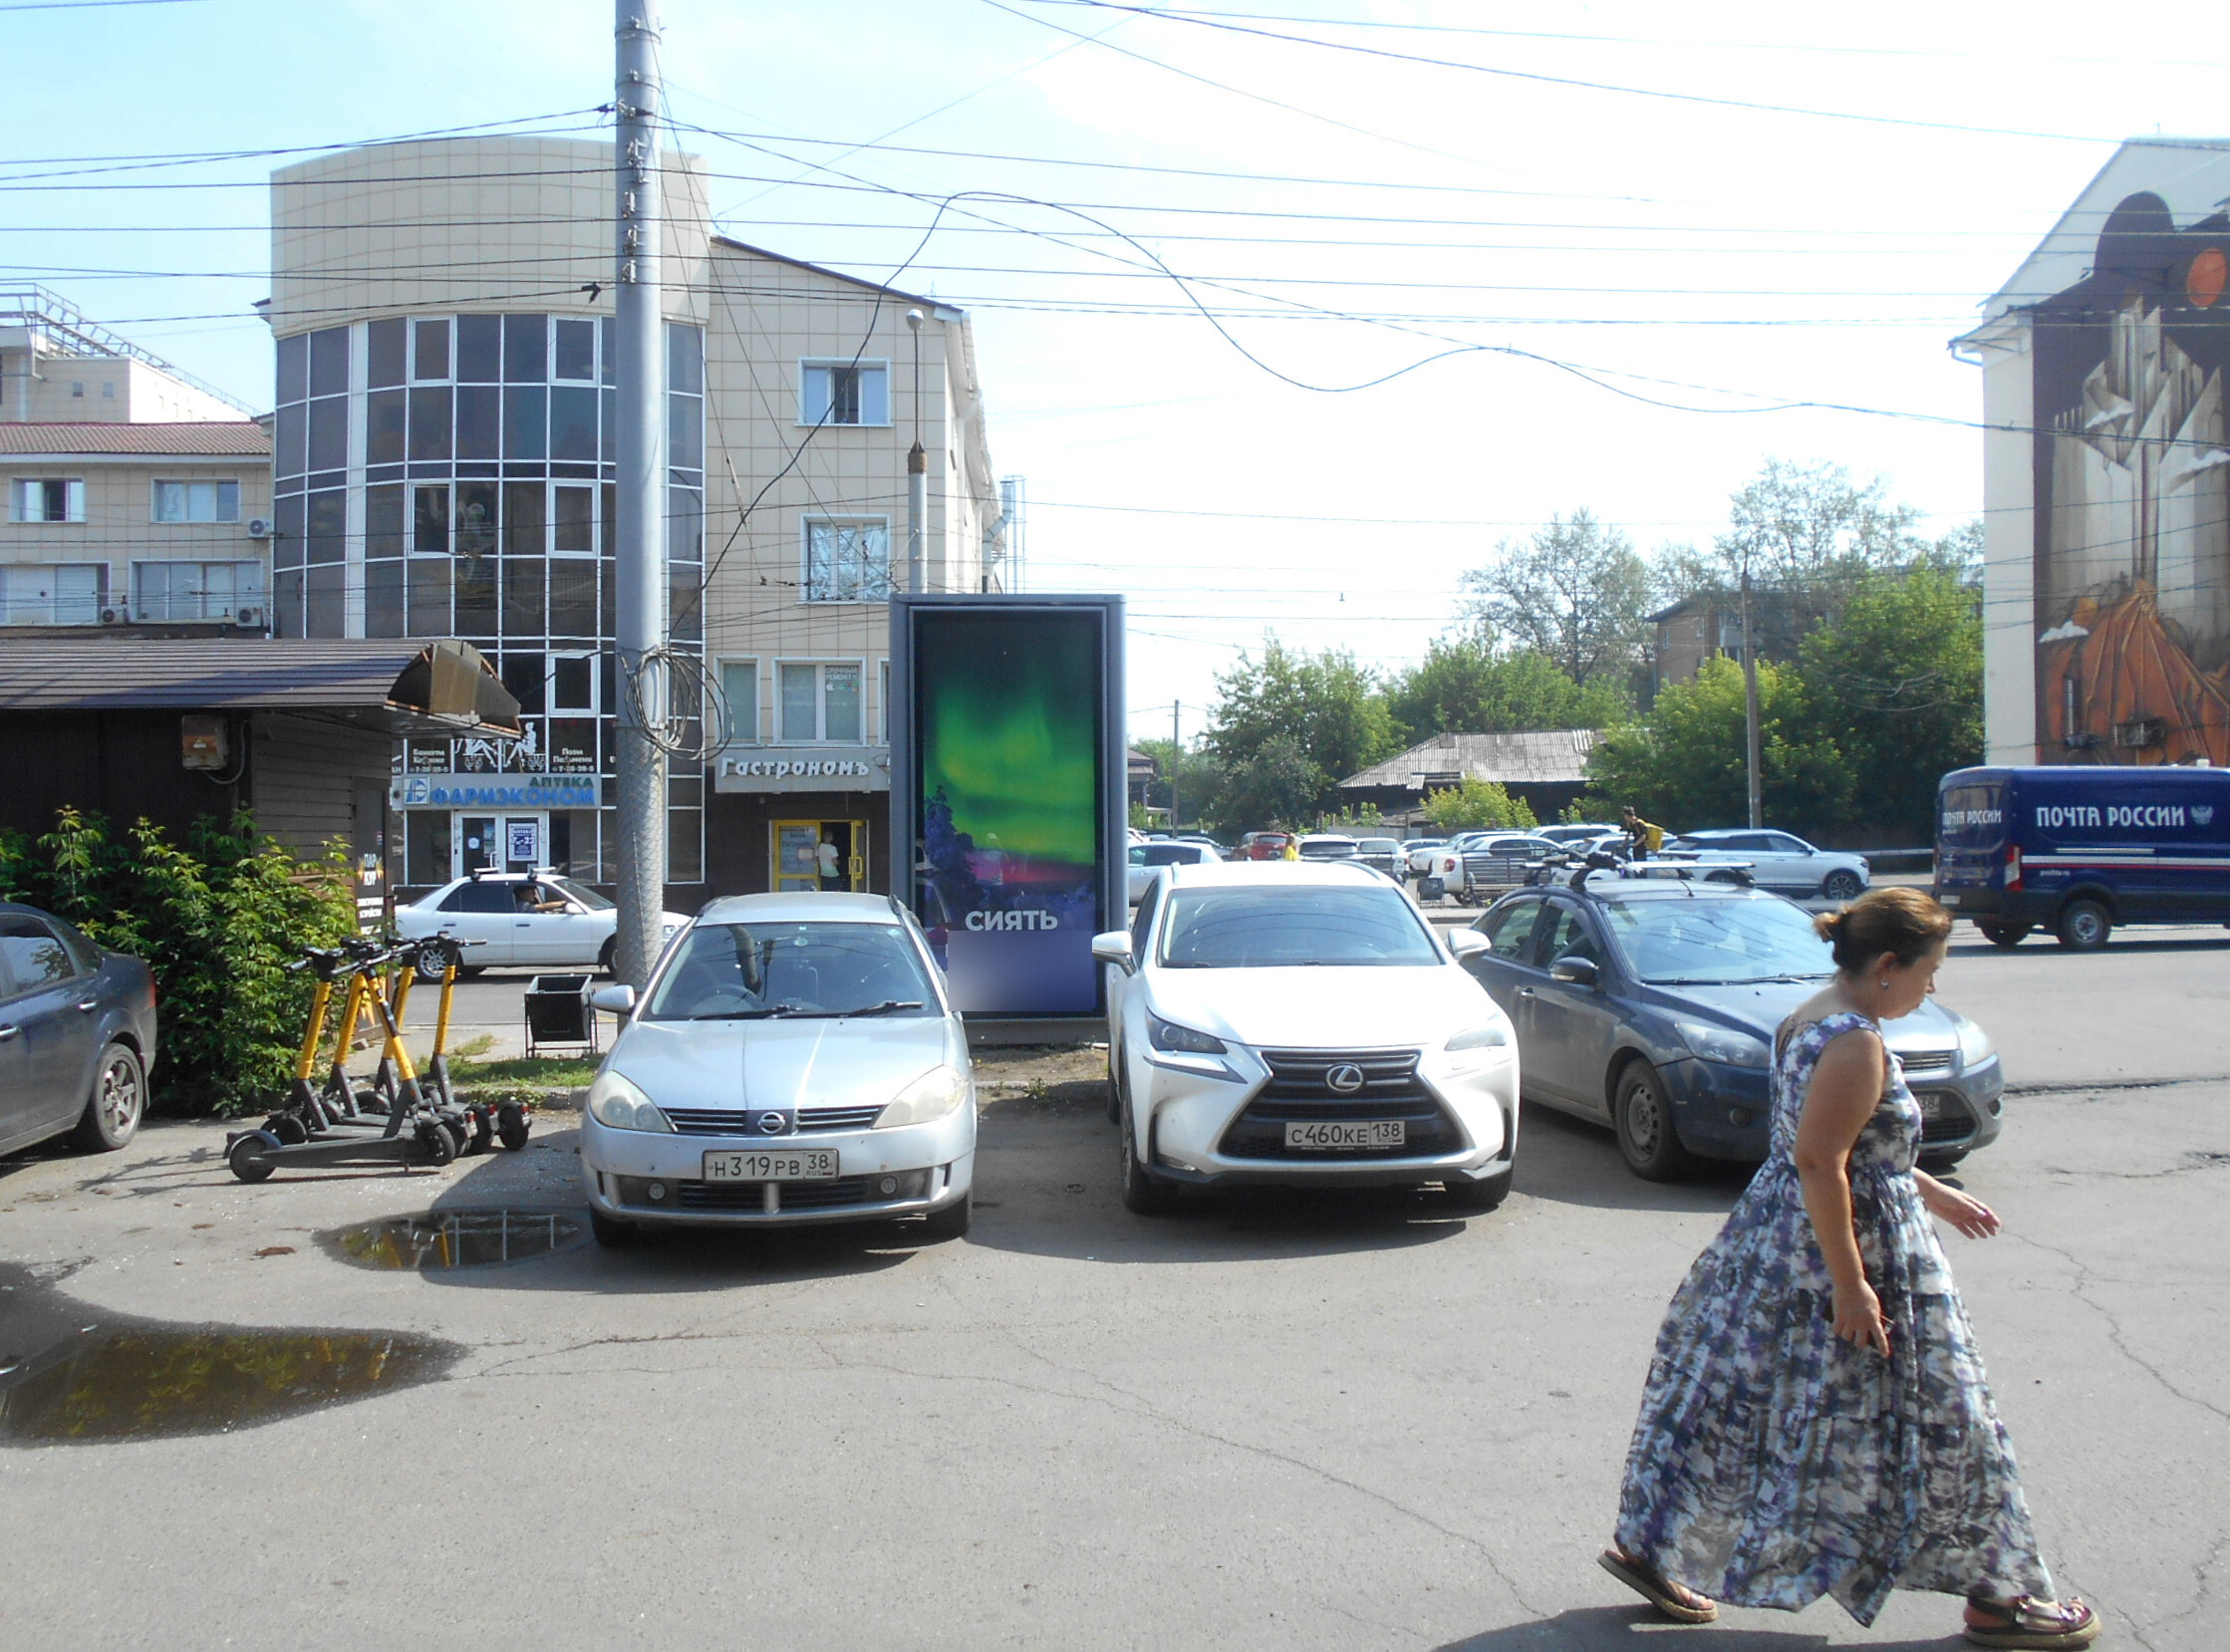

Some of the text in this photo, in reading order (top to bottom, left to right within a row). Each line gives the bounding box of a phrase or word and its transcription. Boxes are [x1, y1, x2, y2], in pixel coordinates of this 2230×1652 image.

[720, 757, 869, 780] Гастрономъ
[529, 776, 594, 787] АПТЕКА
[430, 787, 596, 806] ФАРМЭКОНОМ
[1942, 810, 2002, 825] ПОЧТА РОССИИ
[2037, 806, 2185, 827] ПОЧТА РОССИИ
[965, 910, 1058, 931] СИЯТЬ
